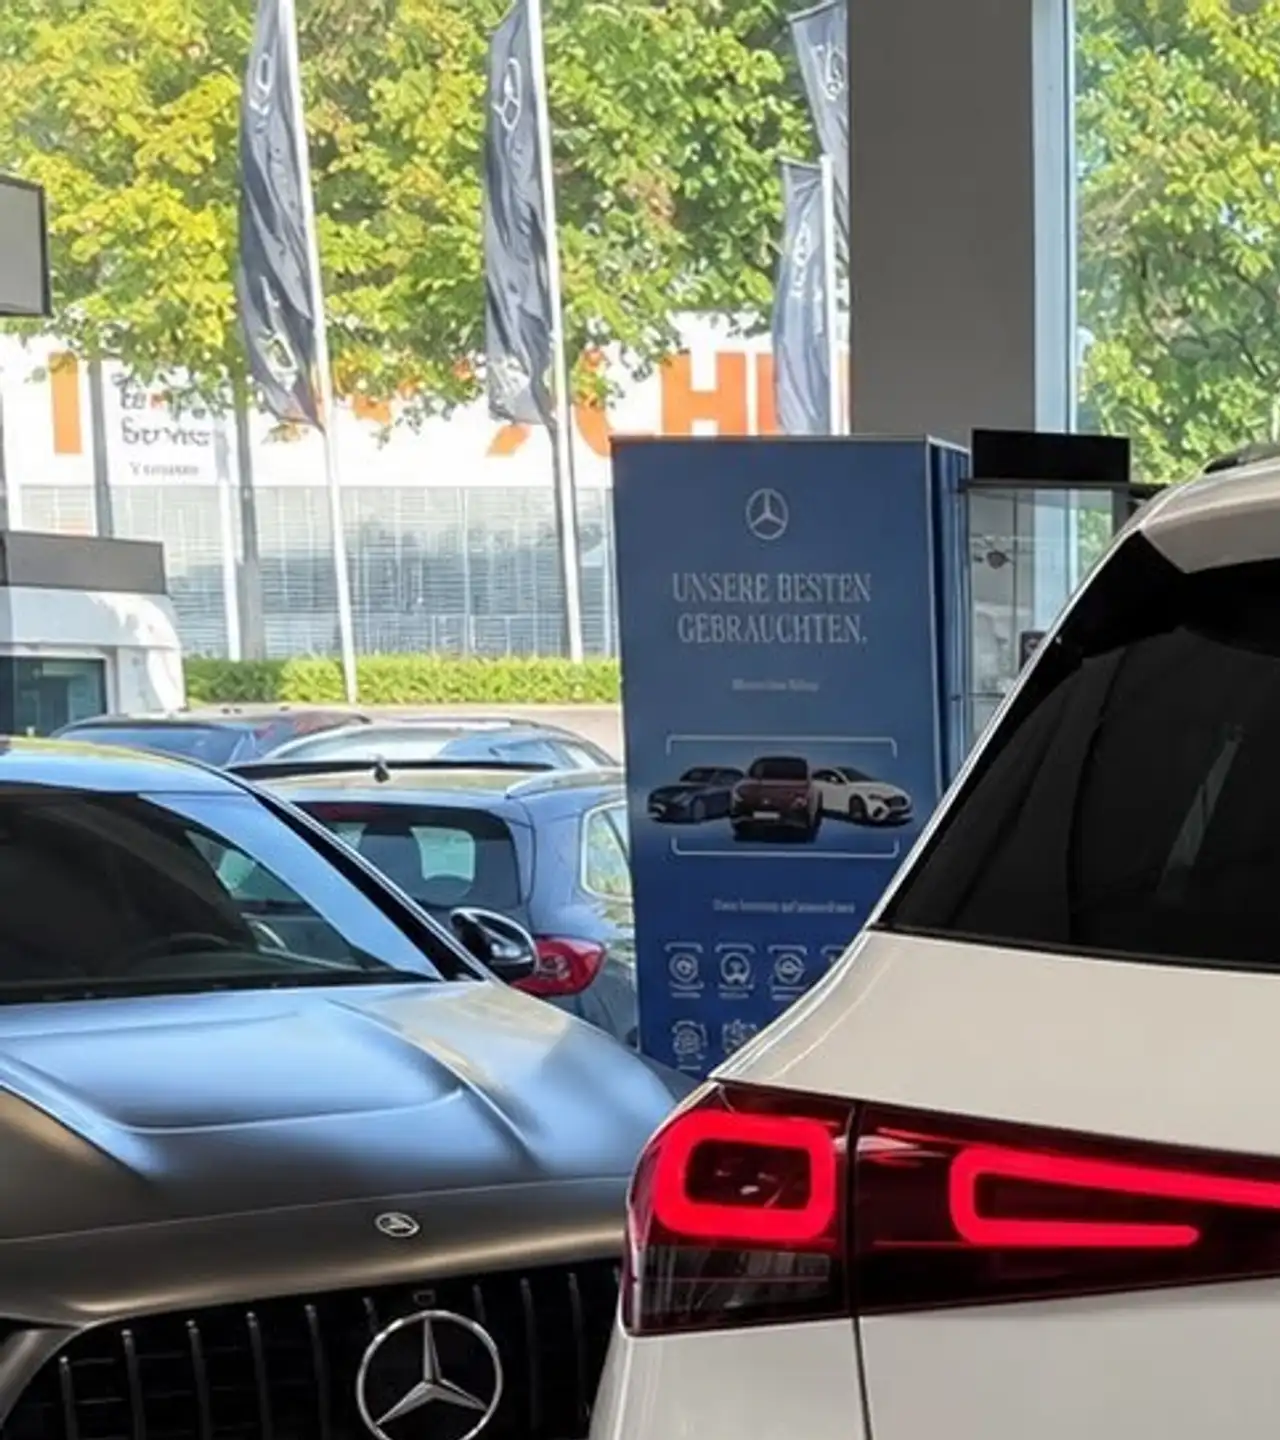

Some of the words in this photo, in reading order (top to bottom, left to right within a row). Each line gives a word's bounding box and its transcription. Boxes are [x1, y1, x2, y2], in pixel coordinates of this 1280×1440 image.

[672, 572, 769, 602] UNSERE
[777, 573, 871, 603] BESTEN
[677, 613, 868, 644] GEBRAUCHTEN.
